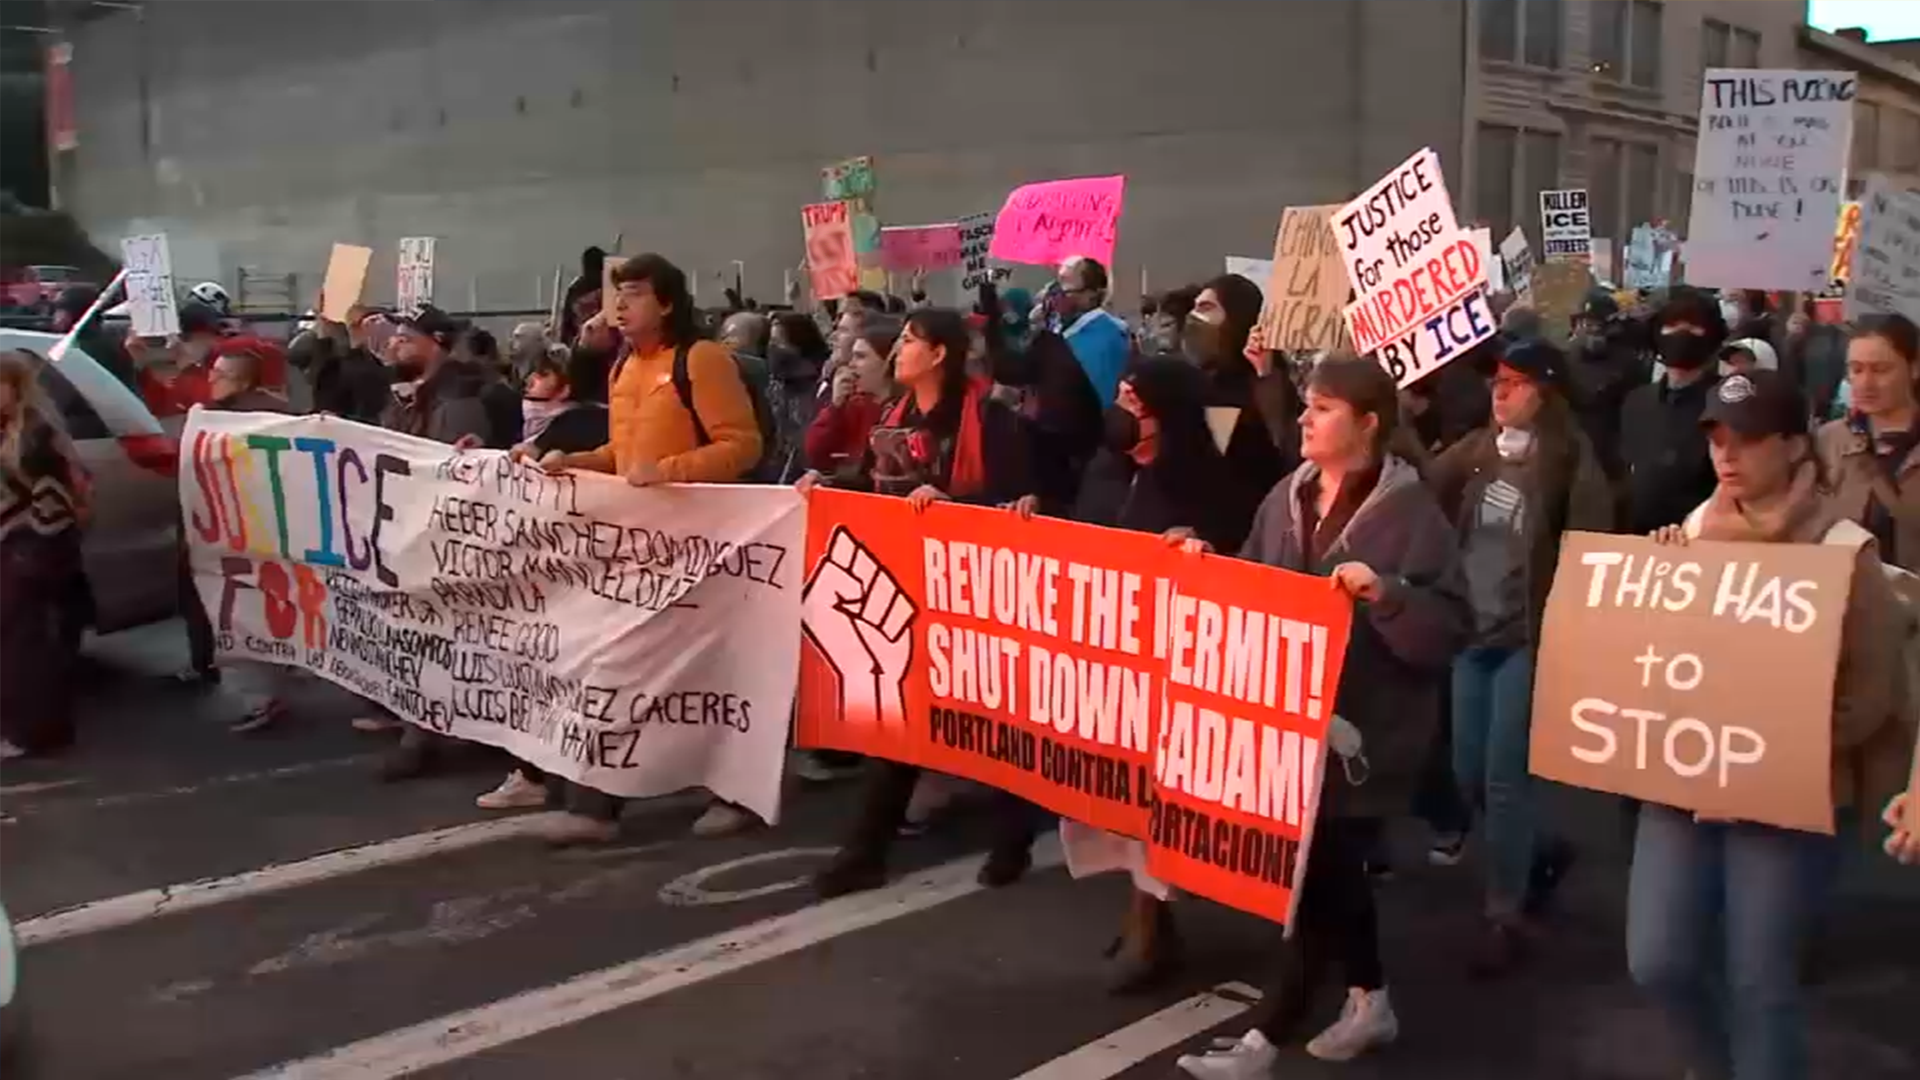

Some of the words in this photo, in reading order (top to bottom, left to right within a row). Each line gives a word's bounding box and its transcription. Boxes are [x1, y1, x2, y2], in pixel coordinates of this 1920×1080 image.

[1708, 78, 1775, 108] THIS
[801, 202, 846, 227] TRUMP
[1341, 157, 1433, 250] JUSTICE
[1544, 192, 1586, 210] KILLER
[1545, 212, 1587, 228] ICE
[1287, 259, 1320, 298] LA
[1355, 258, 1385, 293] for
[1386, 212, 1443, 268] those
[1351, 240, 1480, 349] MURDERED
[1383, 333, 1420, 381] BY
[1425, 290, 1490, 361] ICE
[429, 496, 498, 543] HEBER
[430, 539, 512, 580] VICTOR
[218, 556, 328, 650] FOR
[451, 609, 517, 652] RENEE
[922, 536, 1059, 636] REVOKE
[1068, 562, 1141, 659] THE
[1712, 561, 1819, 634] HAS
[451, 649, 498, 684] LUIS
[629, 691, 752, 733] CACERES
[452, 684, 506, 724] LUIS
[928, 623, 1020, 717] SHUT
[1029, 645, 1150, 753] DOWN
[1634, 644, 1704, 691] to
[929, 705, 1036, 773] PORTLAND
[1040, 737, 1134, 804] CONTRA
[1570, 697, 1767, 788] STOP
